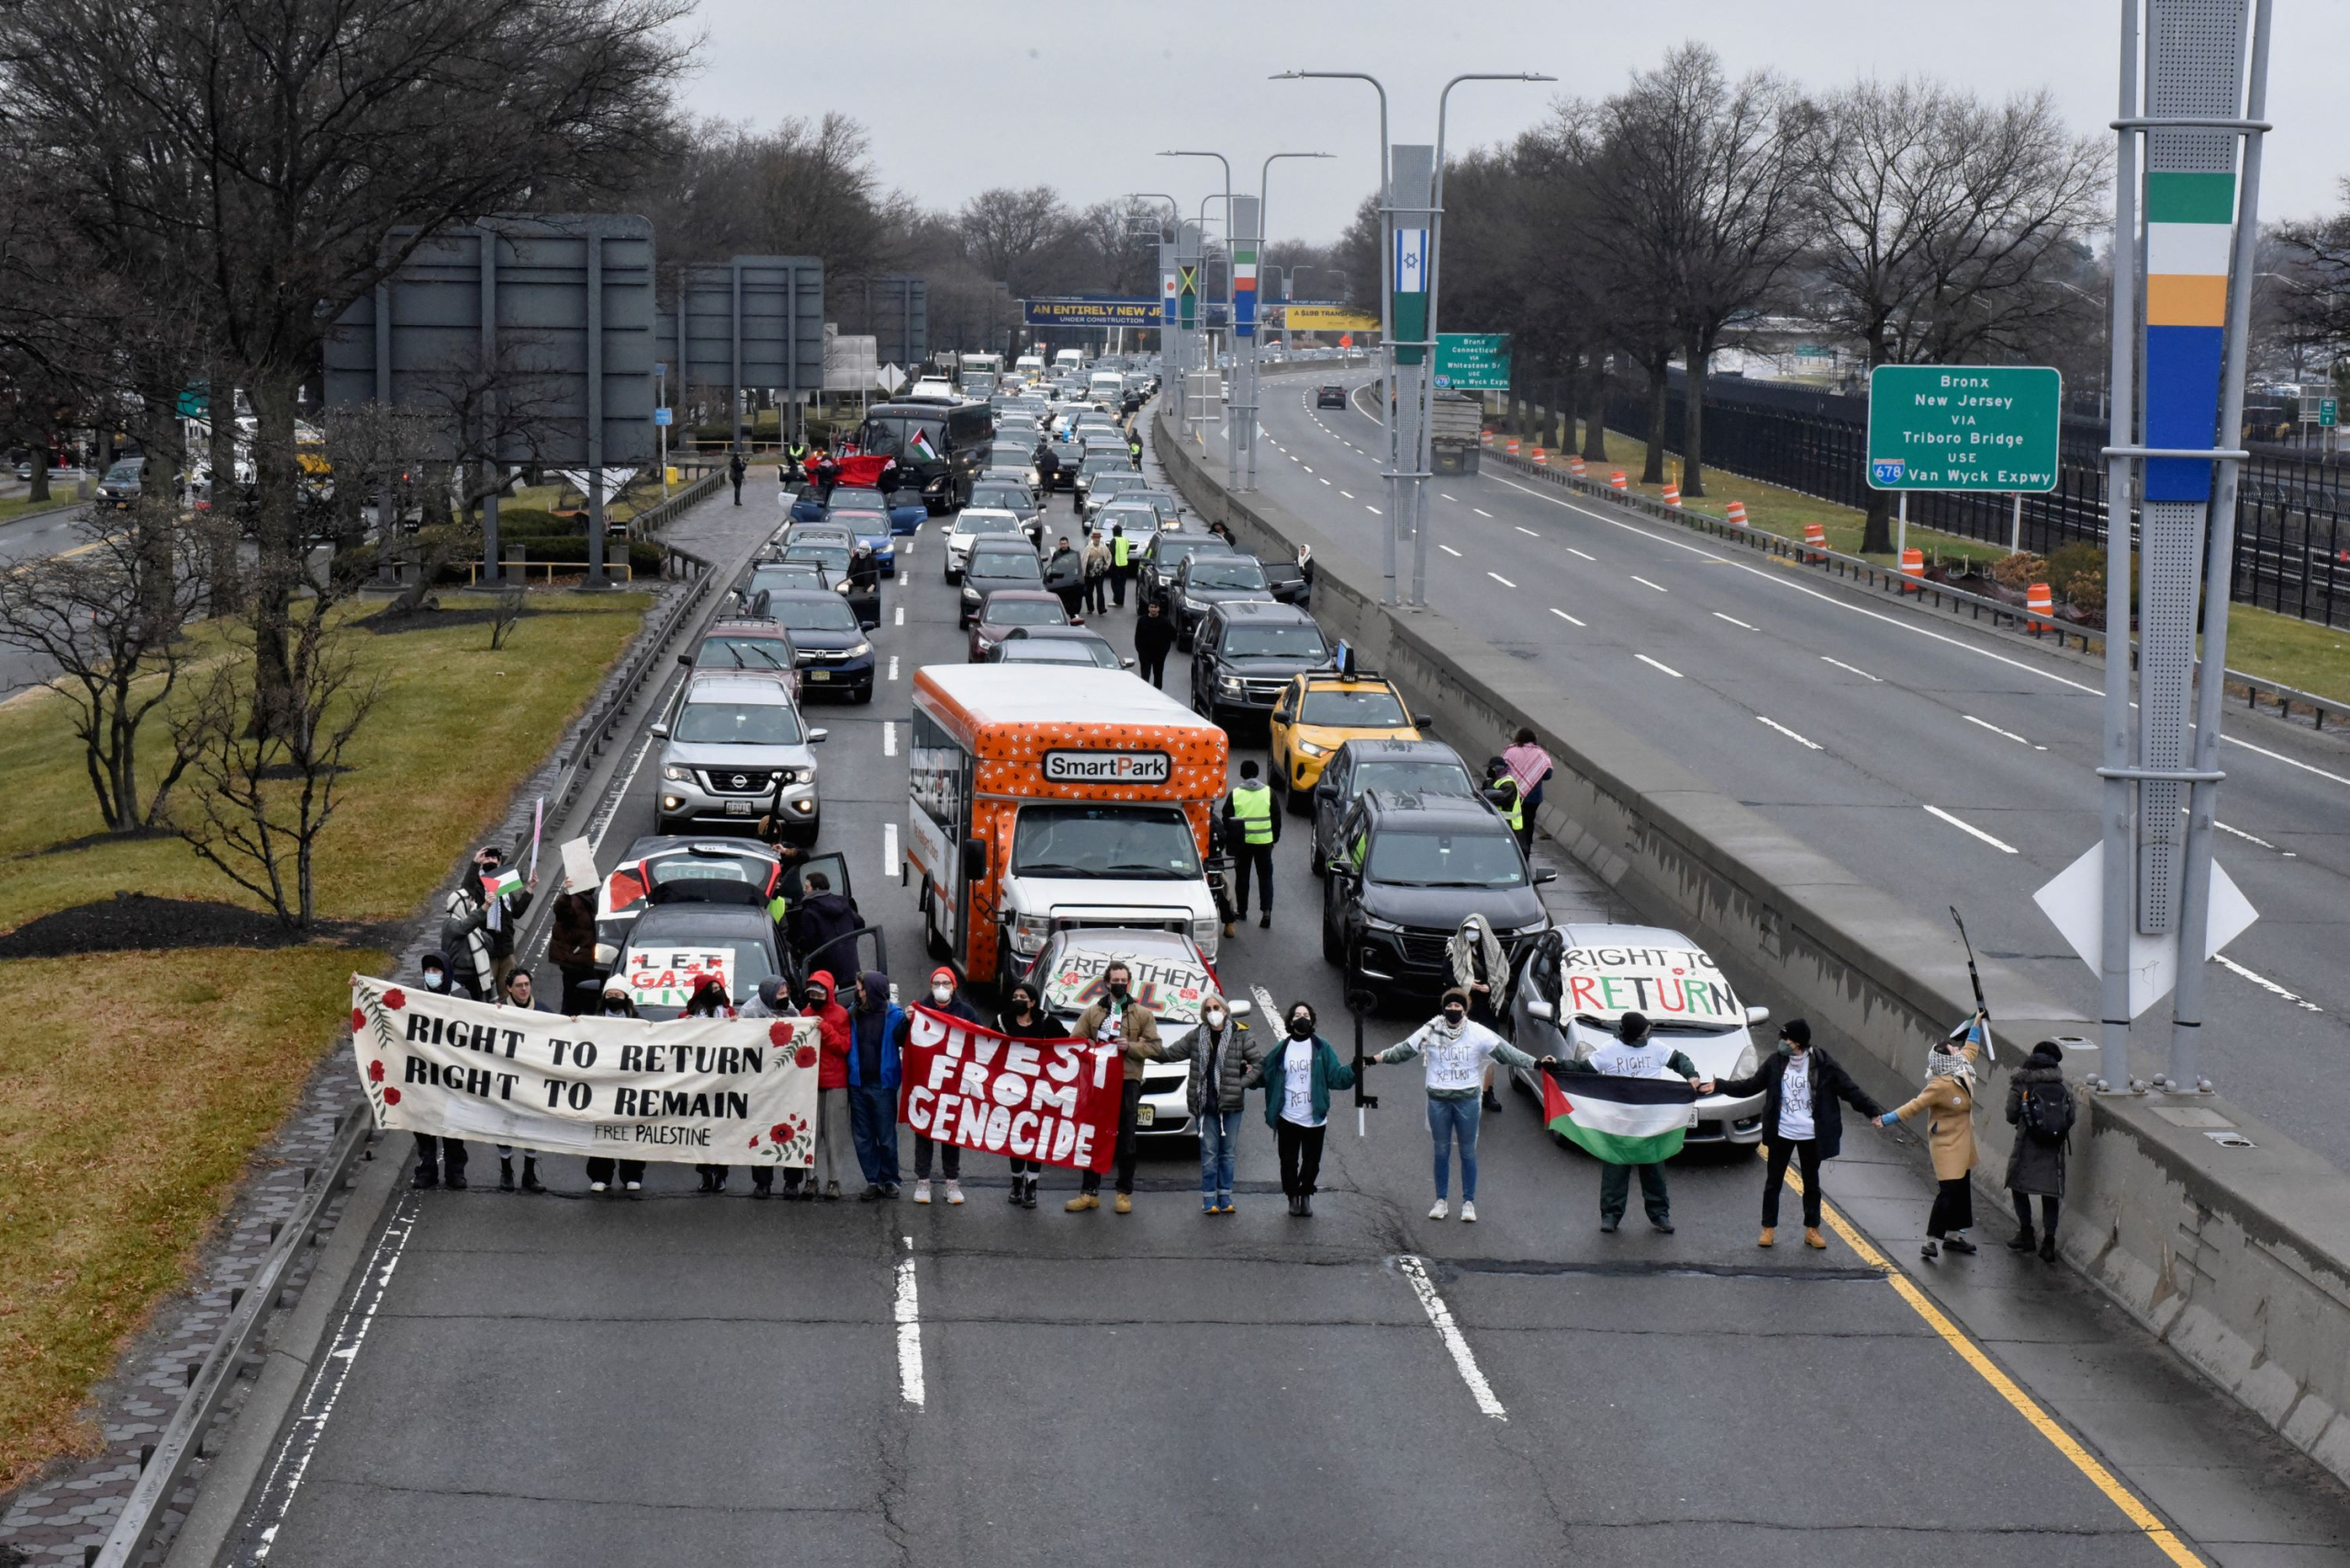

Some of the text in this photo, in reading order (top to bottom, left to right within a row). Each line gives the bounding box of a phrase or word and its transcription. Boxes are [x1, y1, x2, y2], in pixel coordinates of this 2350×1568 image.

[1033, 305, 1050, 314] AN
[1054, 305, 1113, 315] ENTIRELY
[1117, 307, 1146, 316] NEW
[1941, 375, 1989, 387] Bronx
[1915, 395, 2013, 409] New Jersey
[1952, 415, 1976, 425] VIA
[1903, 431, 2024, 448] Triboro Bridge
[1948, 453, 1976, 463] USE
[1875, 465, 1901, 478] 678
[1908, 469, 2051, 486] Van Wyck Expwy
[1051, 756, 1165, 777] SmartPark
[642, 954, 721, 969] LET
[1561, 948, 1717, 969] RIGHT TO
[1058, 958, 1209, 993] FRE THEM
[1074, 977, 1166, 1012] AL
[1570, 977, 1738, 1016] RETURN
[406, 1014, 763, 1075] RIGHT TO RETURN
[911, 1011, 1118, 1089] DIVEST
[1438, 1046, 1471, 1062] RIGHT
[1290, 1059, 1313, 1074] RIGH
[1617, 1057, 1651, 1073] RIGHT
[1437, 1070, 1470, 1082] RETURN
[1782, 1073, 1810, 1091] RIGH
[405, 1055, 748, 1120] RIGHT TO REMAIN
[928, 1055, 1078, 1118] FROM
[1291, 1091, 1312, 1107] RETU
[908, 1085, 1095, 1167] GENOCIDE
[595, 1125, 711, 1147] FREE PALESTINE
